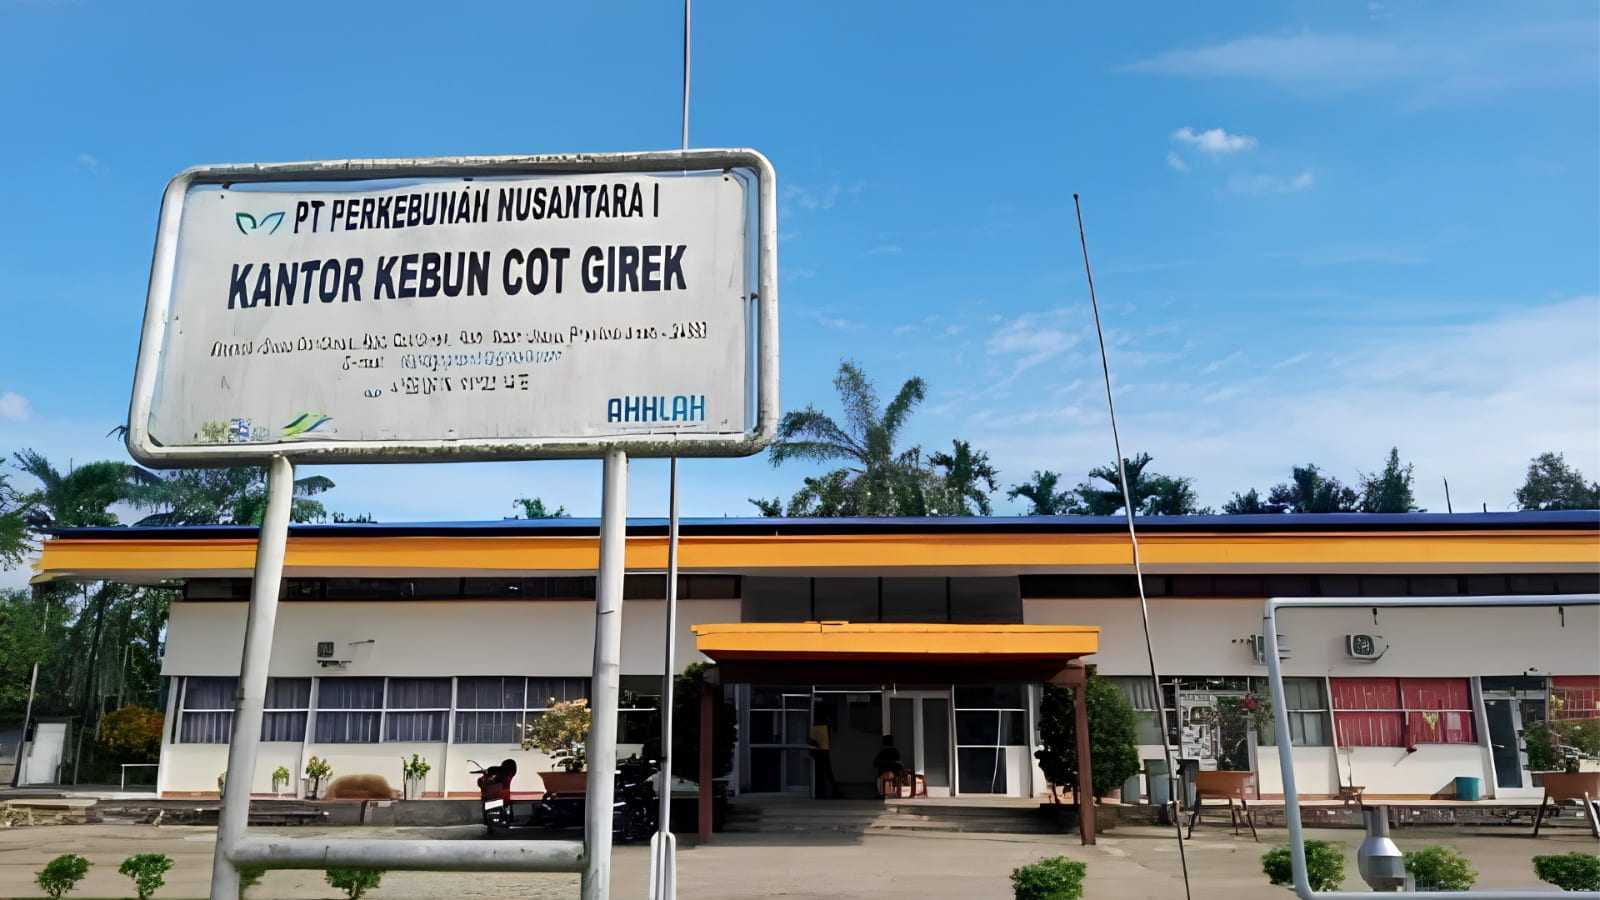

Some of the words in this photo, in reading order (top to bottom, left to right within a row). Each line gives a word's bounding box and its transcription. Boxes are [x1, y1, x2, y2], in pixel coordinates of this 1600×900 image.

[293, 200, 326, 235] PT
[330, 189, 490, 234] PERKEBUNAN
[496, 182, 644, 223] NUSANTARA
[652, 182, 660, 218] I
[227, 257, 364, 310] KANTOR
[373, 250, 491, 301] KEBUN
[502, 247, 571, 296] COT
[581, 244, 688, 294] GIREK
